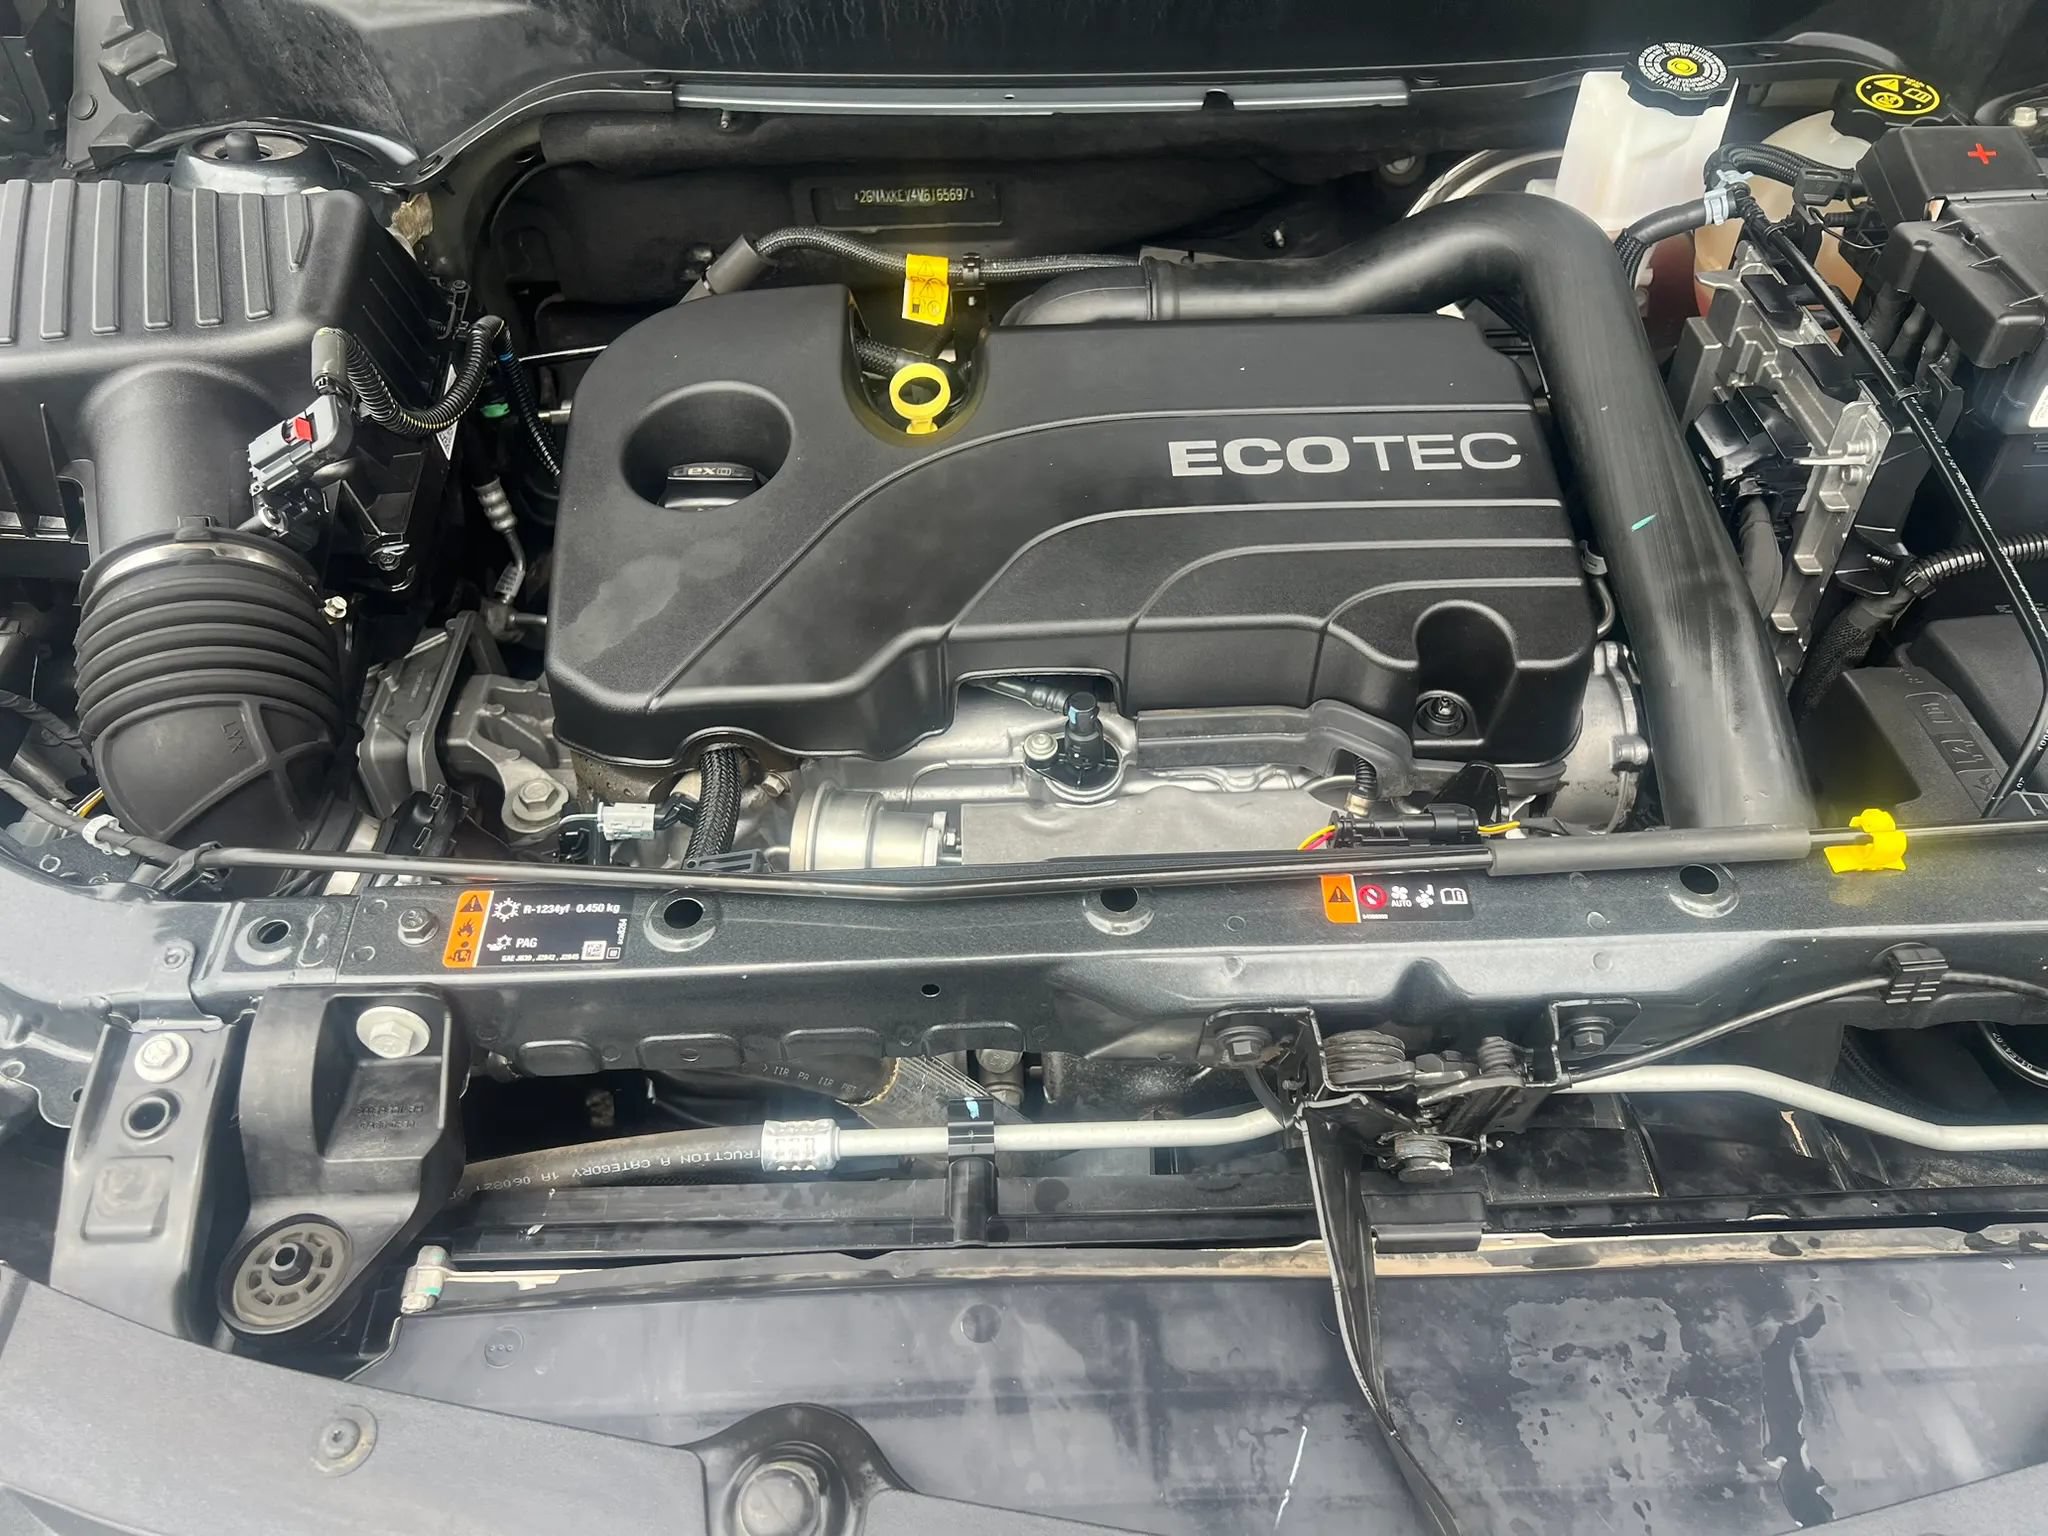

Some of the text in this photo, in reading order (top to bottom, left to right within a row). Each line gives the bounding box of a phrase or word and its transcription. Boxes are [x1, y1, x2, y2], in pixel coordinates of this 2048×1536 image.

[1167, 431, 1523, 477] ECOTEC
[523, 903, 620, 915] R-1234yf 0.450 kg
[1391, 899, 1412, 907] AUTO
[516, 938, 537, 948] PAG
[660, 1156, 671, 1168] A
[572, 1158, 652, 1179] CATEGORY
